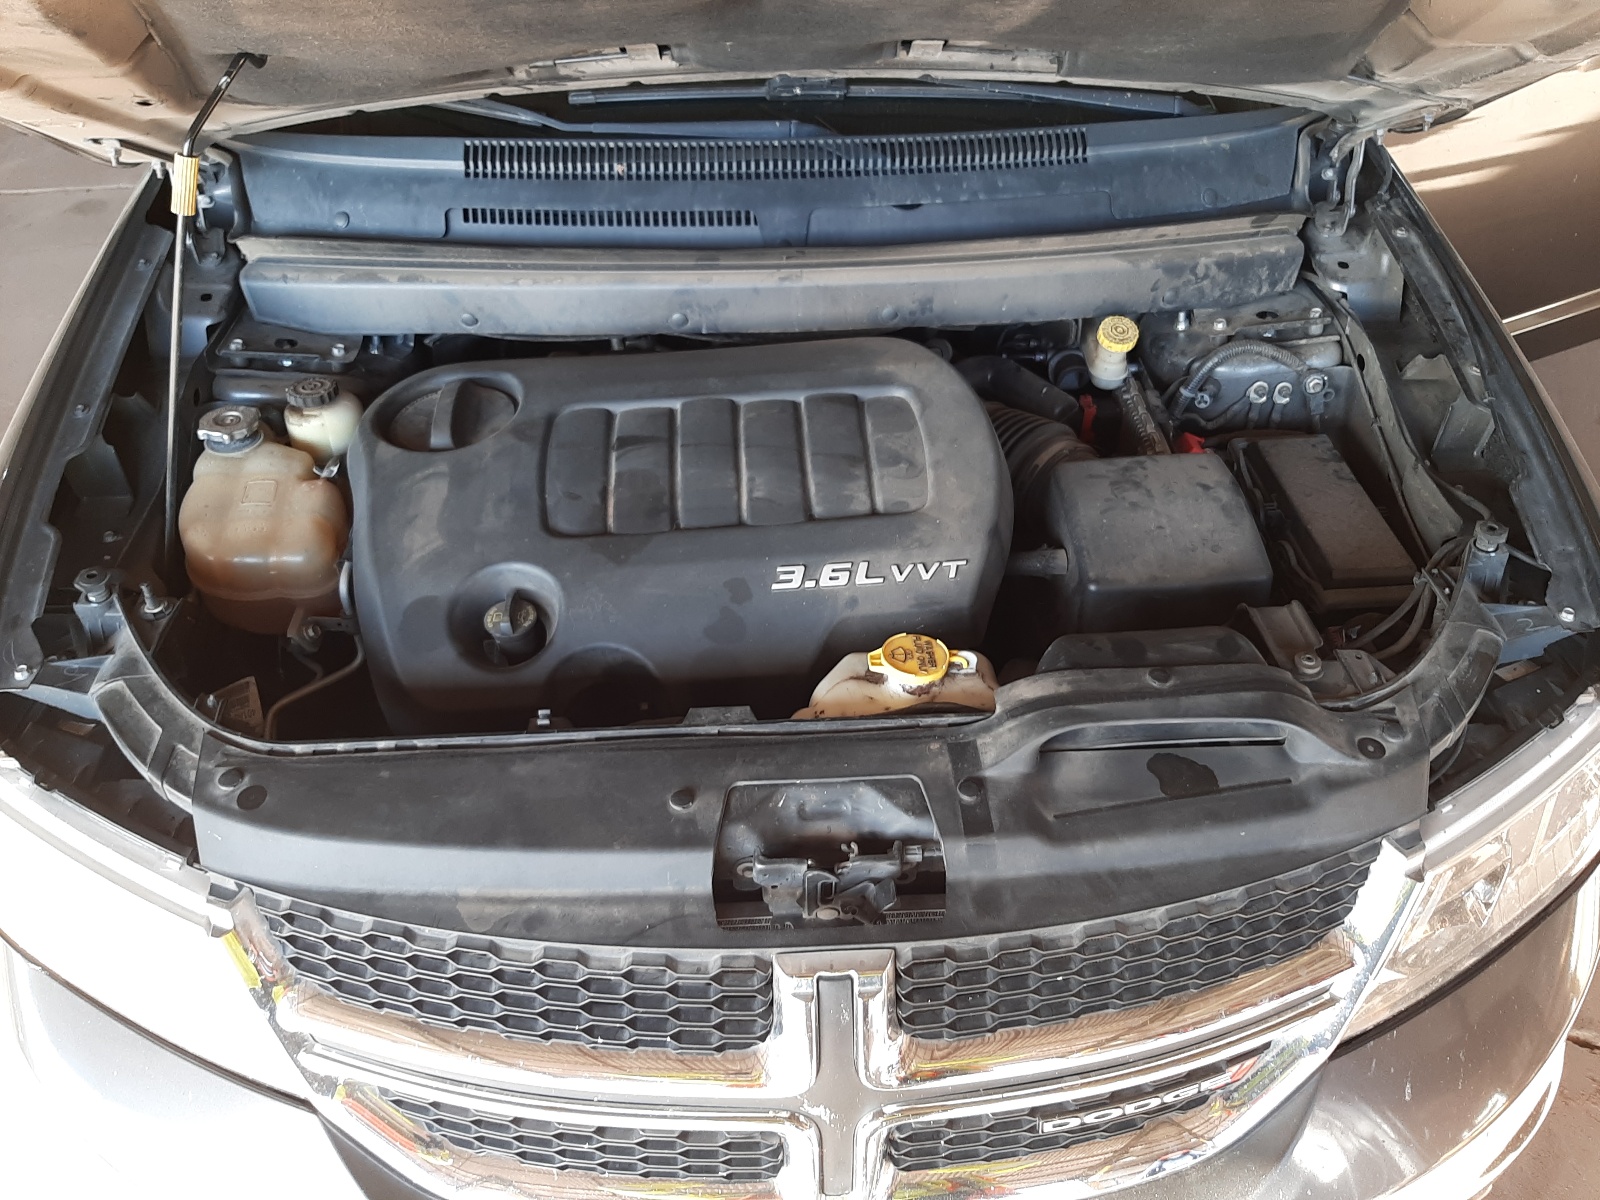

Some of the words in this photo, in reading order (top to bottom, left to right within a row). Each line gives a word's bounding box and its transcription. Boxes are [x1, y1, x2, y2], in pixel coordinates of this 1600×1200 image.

[771, 560, 885, 590] 3.6L
[890, 559, 968, 582] VVT
[1042, 1071, 1232, 1133] DODGE
